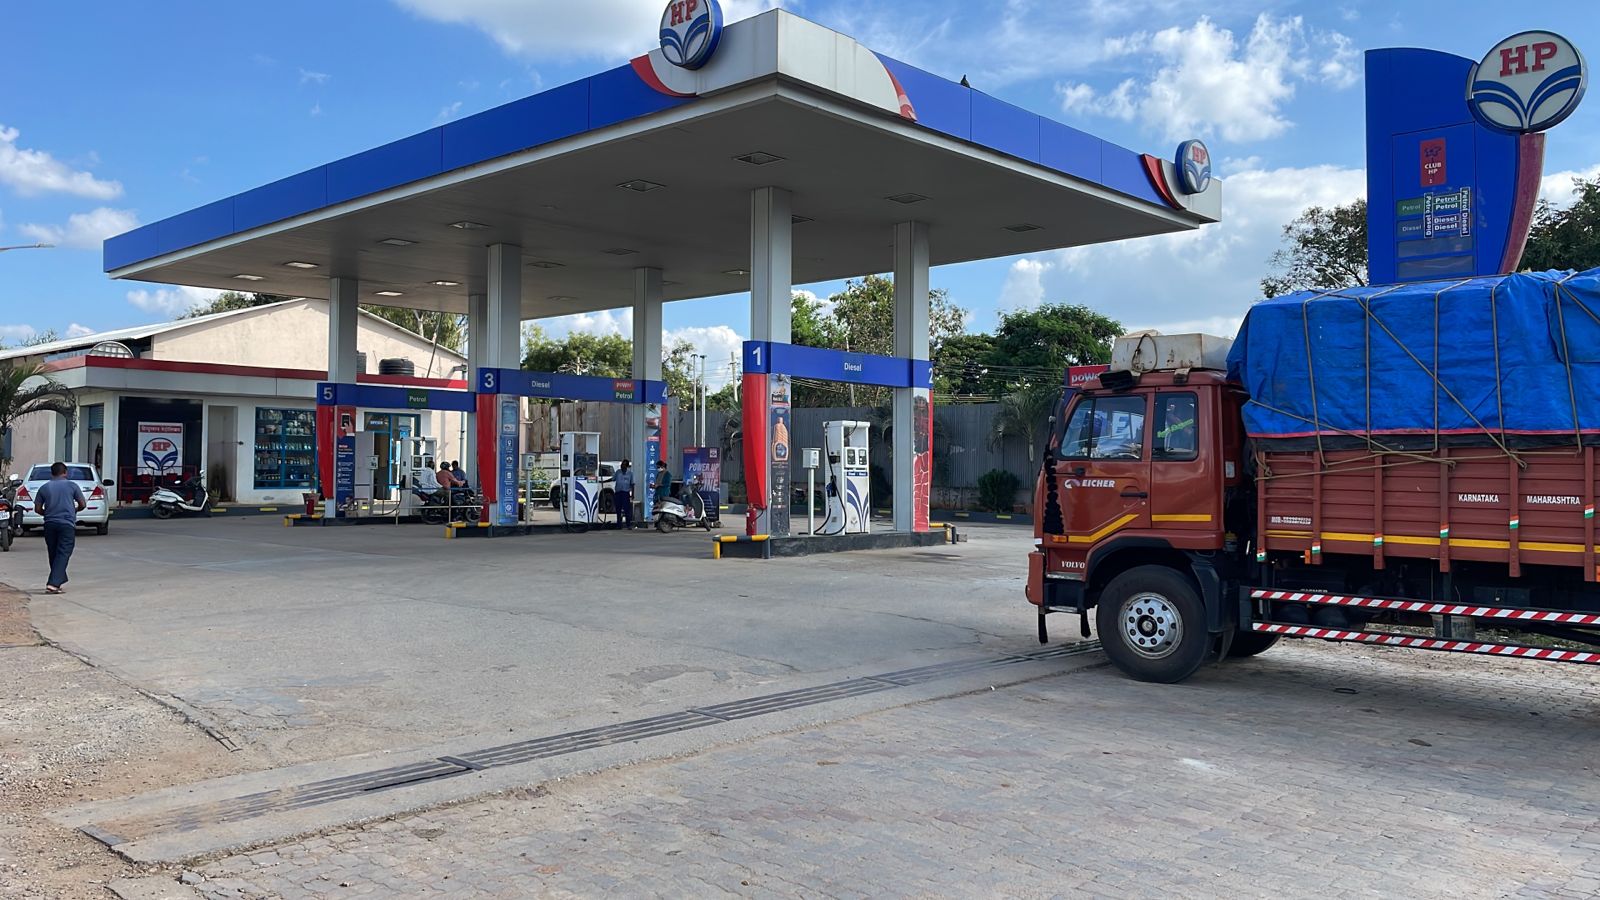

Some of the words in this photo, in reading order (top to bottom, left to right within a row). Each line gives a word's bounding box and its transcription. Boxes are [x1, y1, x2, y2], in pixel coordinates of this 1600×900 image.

[670, 0, 697, 26] HP
[1500, 41, 1557, 77] HP
[1435, 195, 1458, 203] Petrol
[1434, 215, 1457, 223] Diesel
[1434, 223, 1458, 231] Diesel
[752, 346, 761, 366] 1
[844, 362, 862, 372] Diesel
[484, 372, 495, 388] 3
[928, 367, 934, 384] 2
[531, 380, 550, 388] Diesel
[323, 387, 333, 401] 5
[615, 391, 633, 400] Petrol
[661, 386, 668, 400] 4
[152, 441, 171, 451] HP
[688, 462, 710, 472] POWER
[1082, 479, 1115, 488] EICHER
[1458, 494, 1499, 503] KARNATAKA
[1526, 495, 1581, 505] MAHARASHTRA
[1061, 560, 1086, 569] VOLVO
